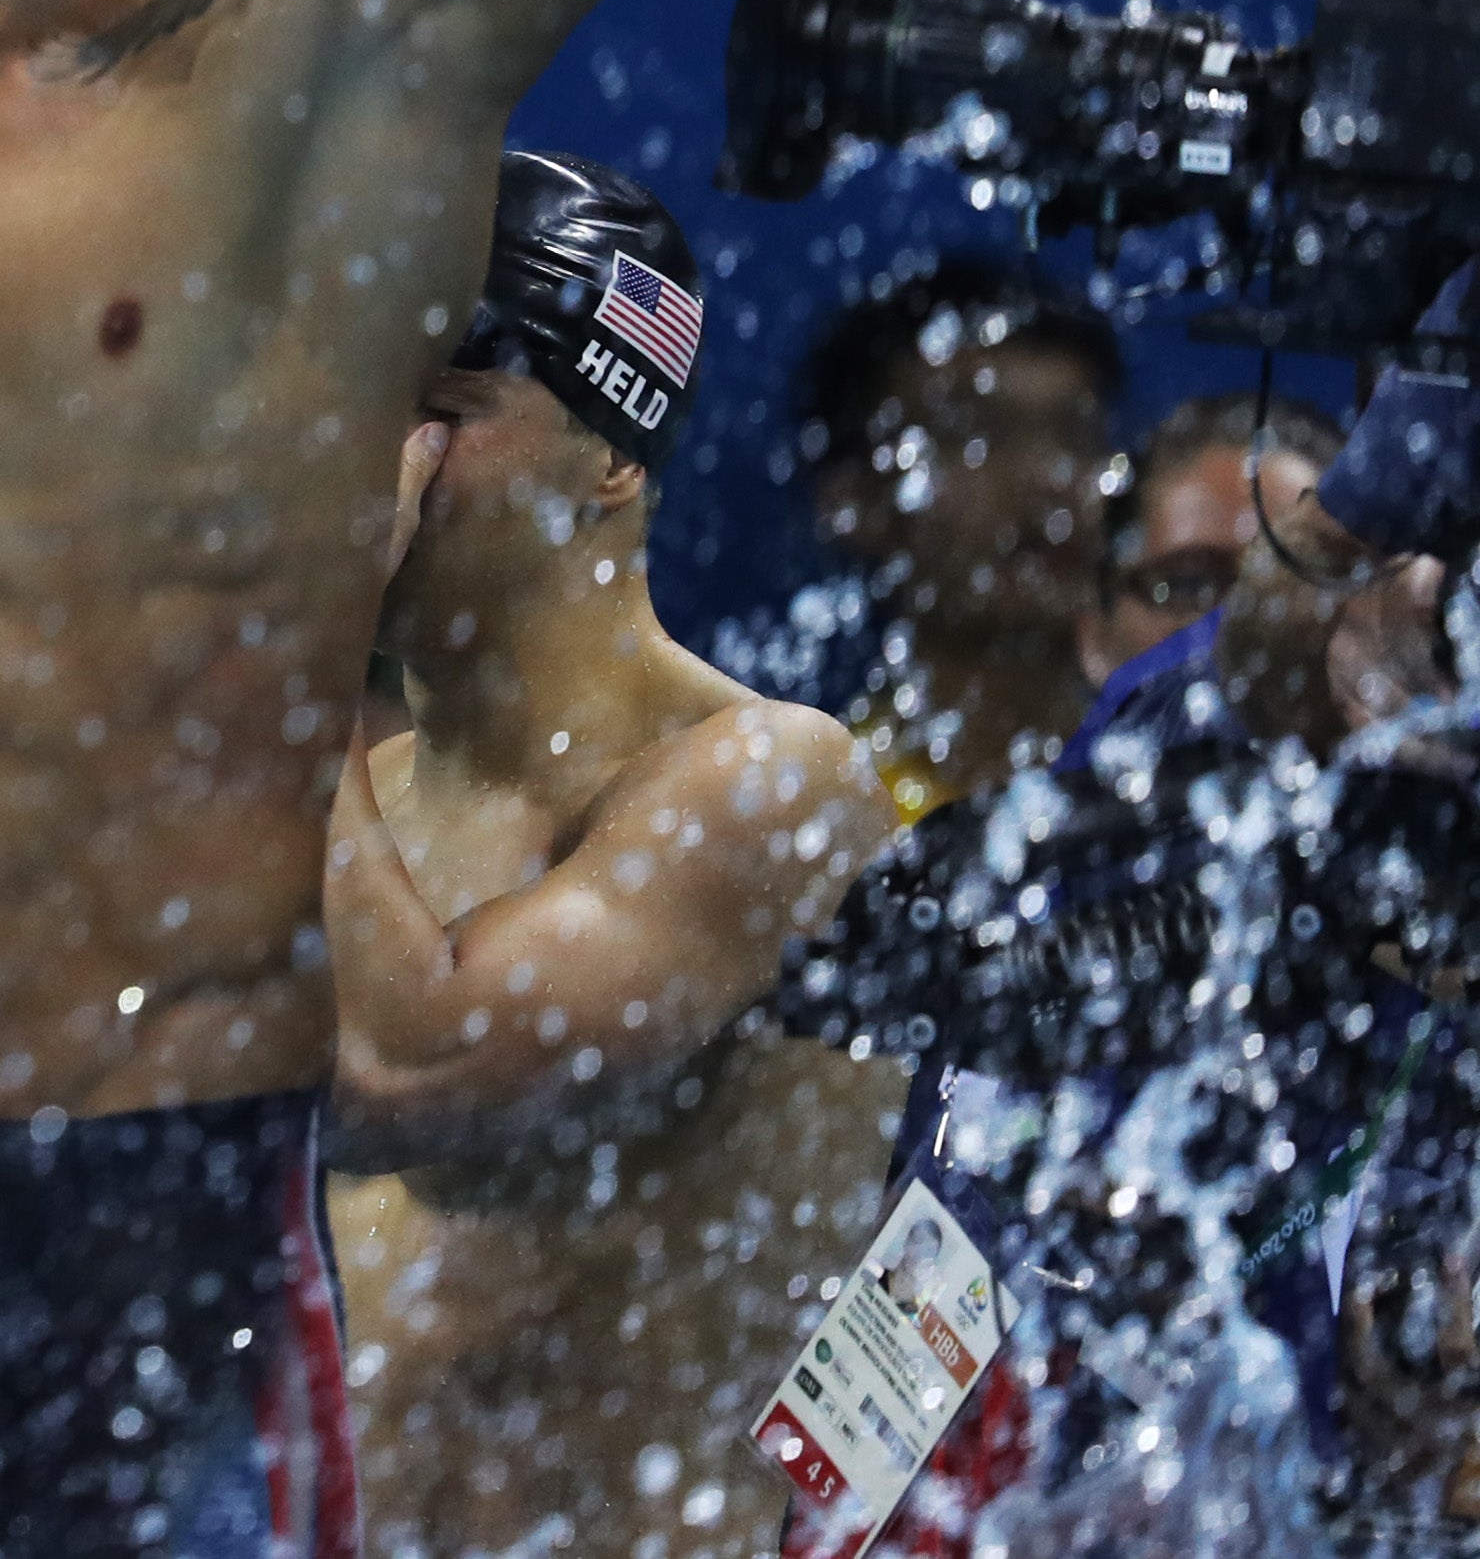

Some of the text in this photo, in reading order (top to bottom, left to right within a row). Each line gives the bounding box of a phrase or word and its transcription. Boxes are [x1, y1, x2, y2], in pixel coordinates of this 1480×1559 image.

[574, 339, 669, 430] HELD
[929, 1323, 961, 1368] HBb
[806, 1461, 836, 1499] 4 5
